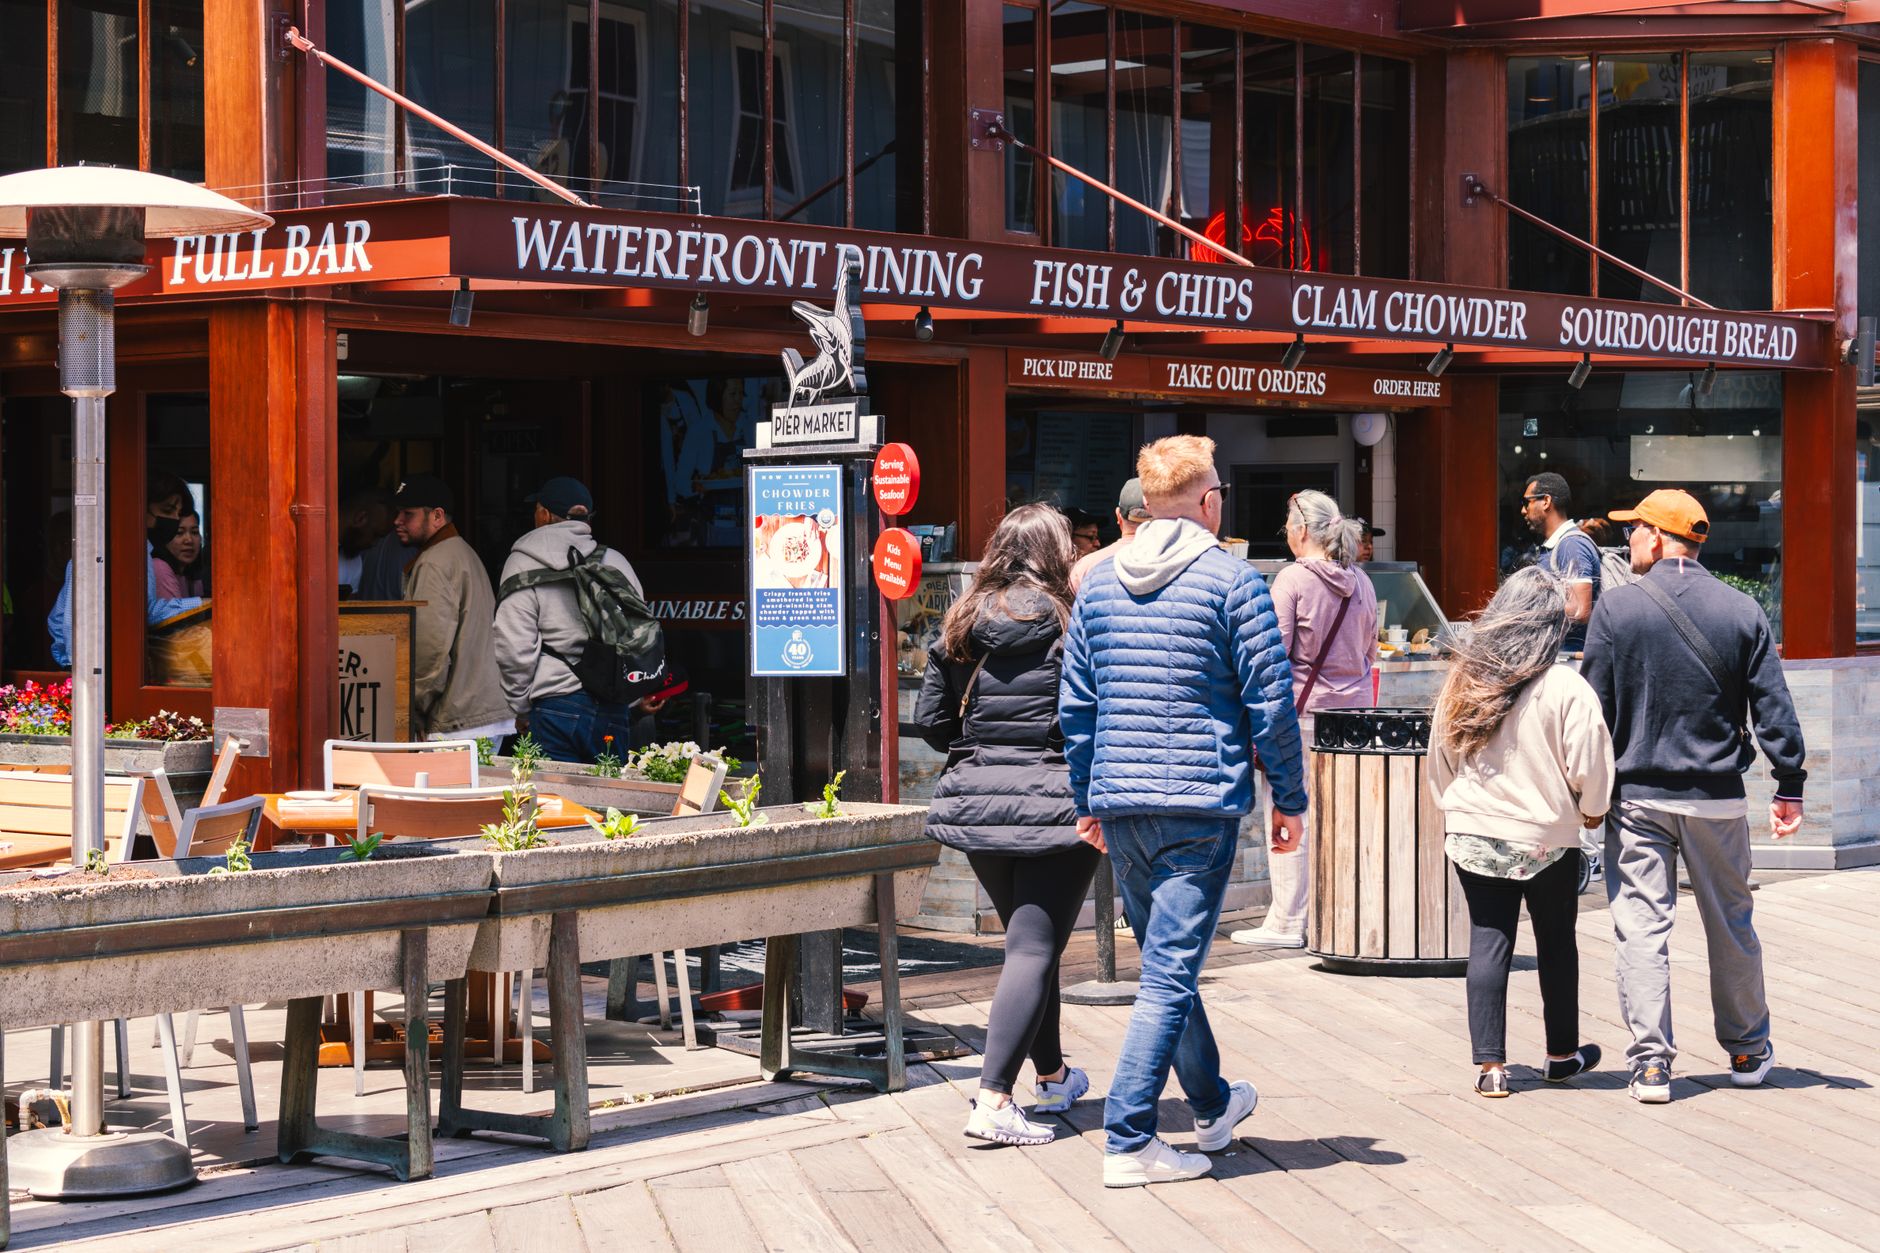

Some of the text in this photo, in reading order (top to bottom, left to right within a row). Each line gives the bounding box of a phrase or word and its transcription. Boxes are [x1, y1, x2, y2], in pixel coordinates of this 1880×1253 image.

[169, 219, 373, 285] FULL BAR
[511, 216, 984, 300] WATERFRONT DINING
[1029, 259, 1254, 322] FISH & CHIPS
[1291, 284, 1527, 340] CLAM CHOWDER
[1559, 306, 1798, 361] SOURDOUGH BREAD
[1023, 358, 1113, 380] PICK UP HERE
[1167, 363, 1326, 396] TAKE OUT ORDERS
[1374, 379, 1441, 398] ORDER HERE
[775, 411, 852, 436] PIER MARKET
[880, 459, 904, 472] Serving
[874, 474, 910, 485] Sustainable
[762, 488, 831, 499] CHOWDER
[879, 489, 905, 500] Seafood
[777, 501, 815, 511] FRIES
[886, 543, 901, 557] Kids
[884, 558, 902, 571] Menu
[879, 571, 907, 587] available
[646, 600, 729, 619] AINABLE
[788, 643, 807, 656] 40
[340, 682, 381, 742] KET
